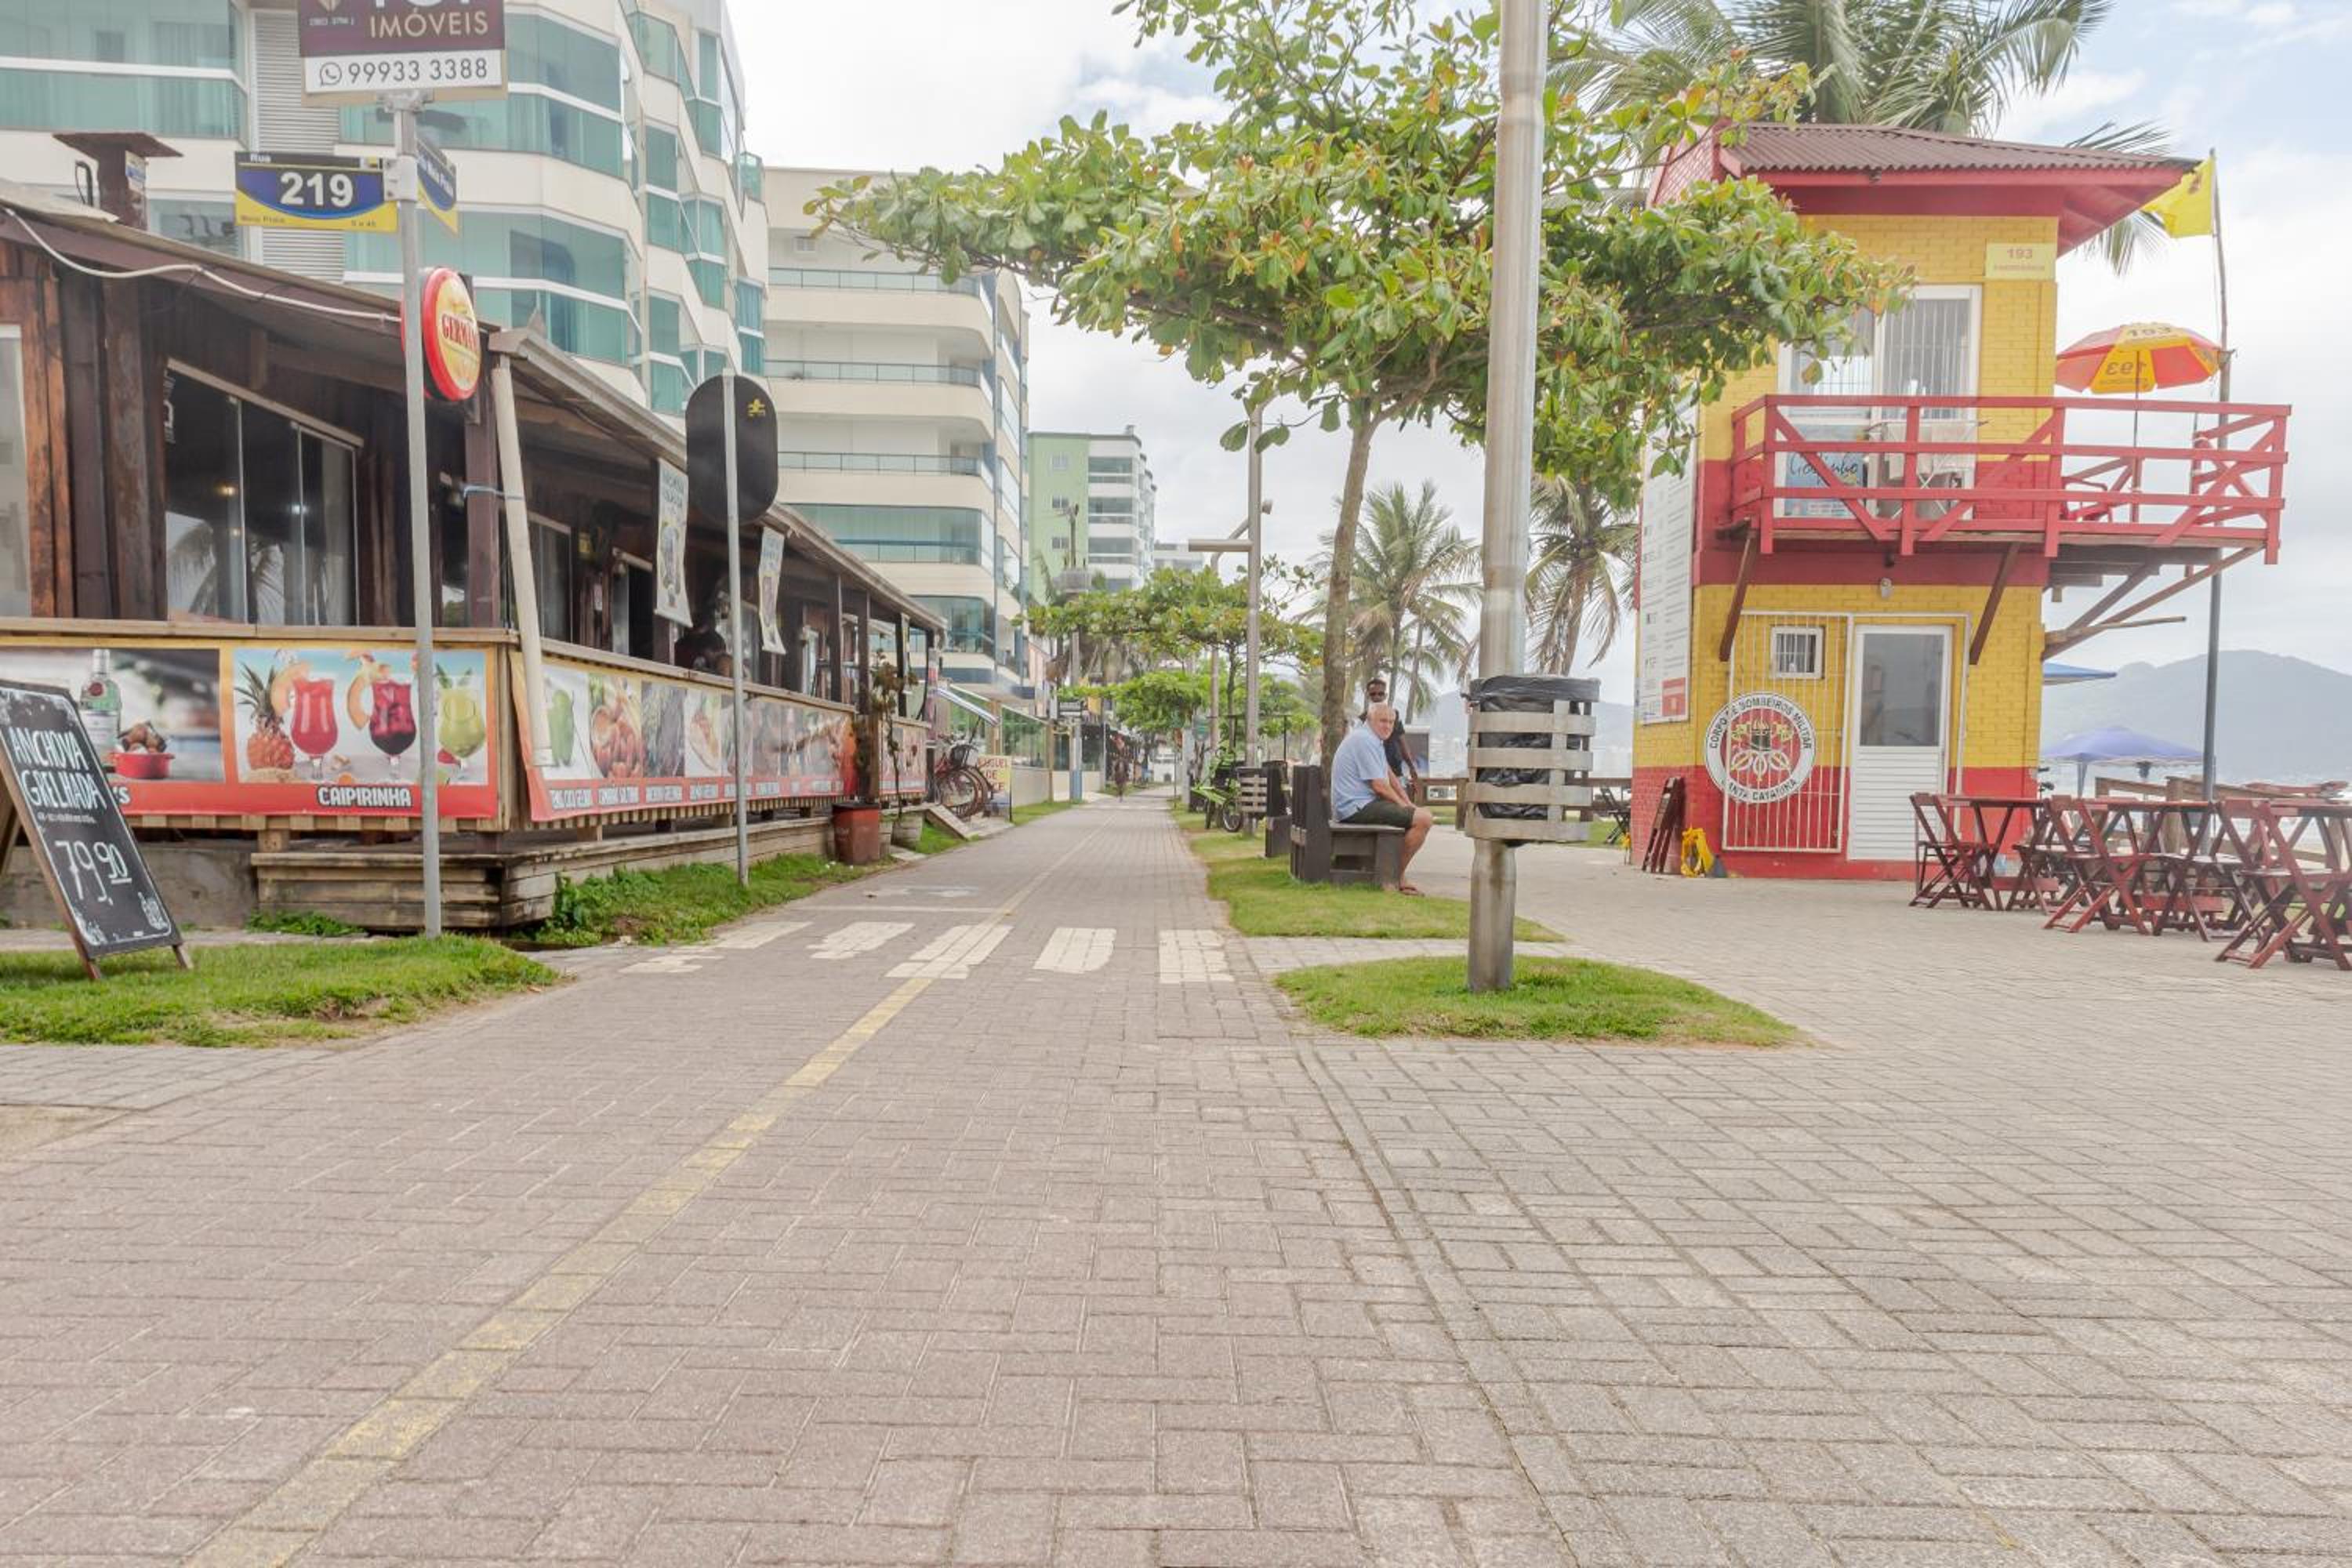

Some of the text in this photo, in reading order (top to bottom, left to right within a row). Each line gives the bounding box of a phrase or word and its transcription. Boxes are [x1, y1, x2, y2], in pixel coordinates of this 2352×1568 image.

[370, 8, 489, 38] IMÓVEIS
[348, 57, 488, 84] 99933 3388
[249, 153, 271, 162] Rua
[279, 171, 354, 208] 219
[2007, 248, 2032, 260] 193
[9, 726, 89, 771] ANCHOVA
[21, 769, 107, 811] GRELHADA
[318, 786, 412, 808] CAIPIRINHA
